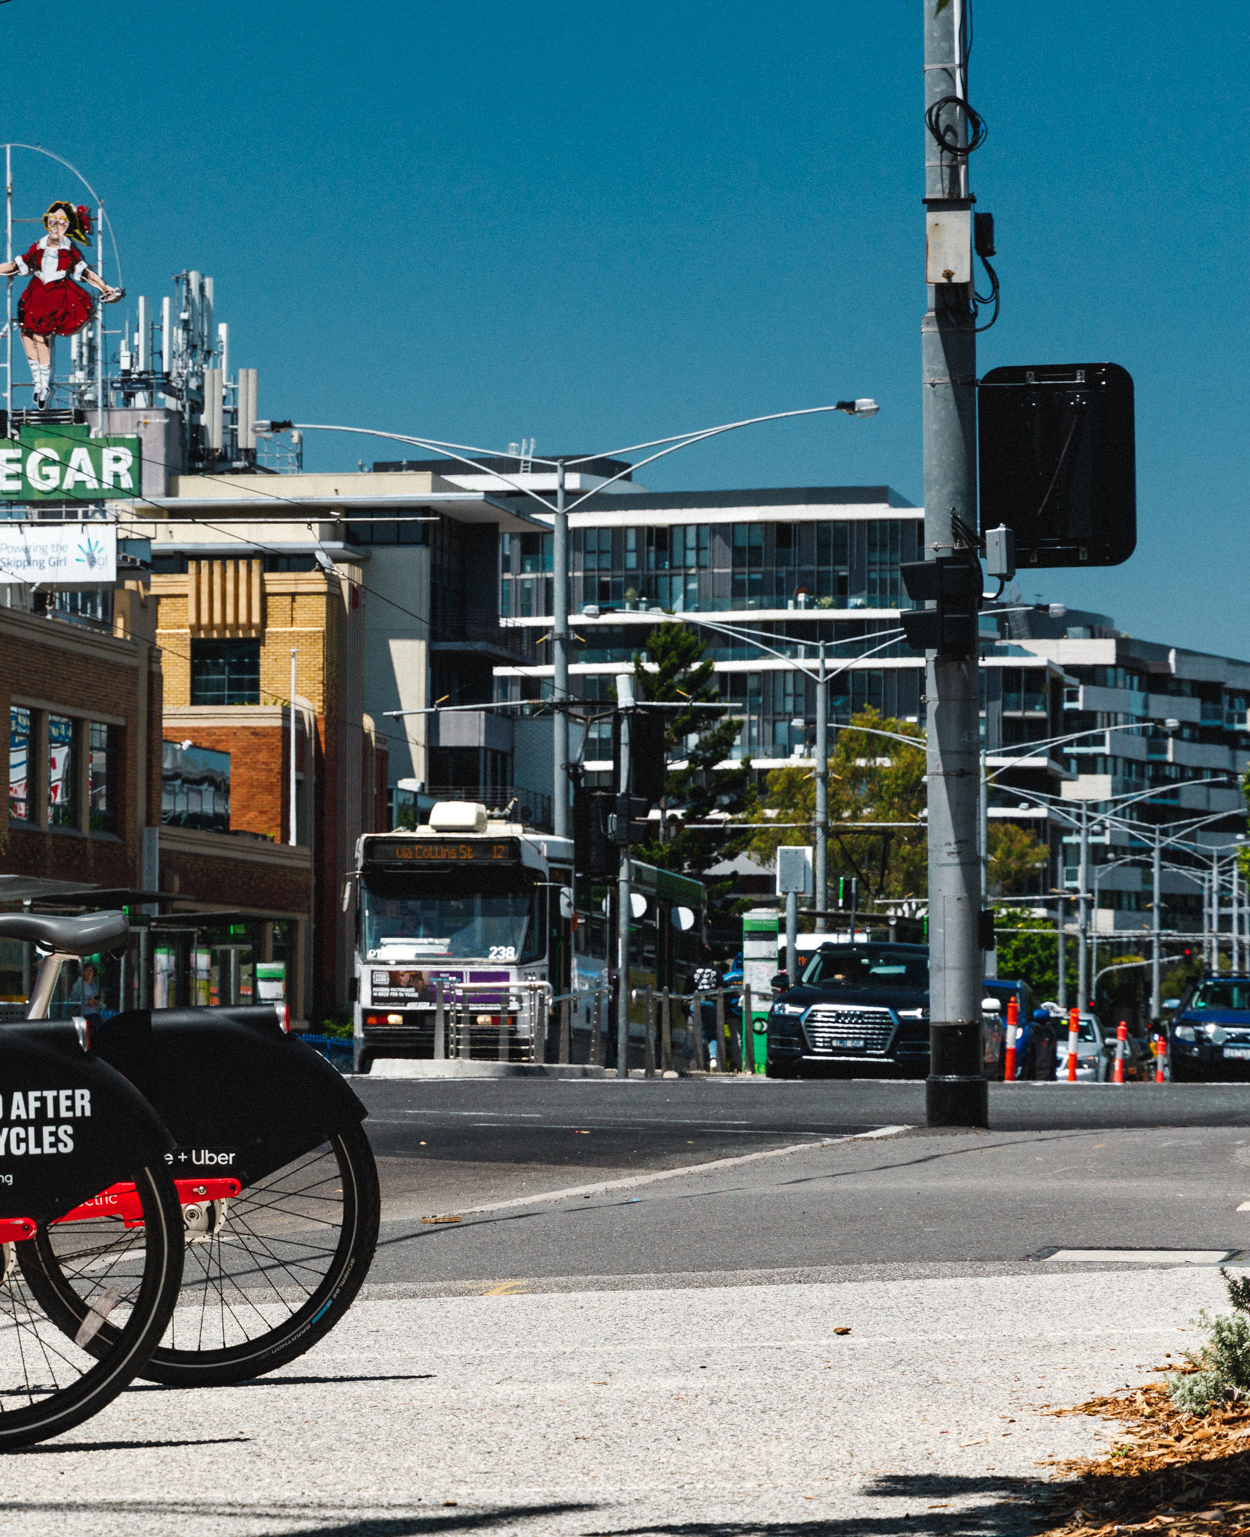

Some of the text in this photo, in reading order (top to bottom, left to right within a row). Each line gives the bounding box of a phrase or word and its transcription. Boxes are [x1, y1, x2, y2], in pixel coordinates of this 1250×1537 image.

[0, 543, 68, 555] Powering the
[0, 556, 67, 569] Skipping Girl
[396, 845, 413, 859] via
[459, 845, 474, 859] St
[493, 845, 505, 859] 12
[488, 946, 515, 960] 238
[10, 1088, 92, 1120] AFTER
[191, 1149, 235, 1165] Uber
